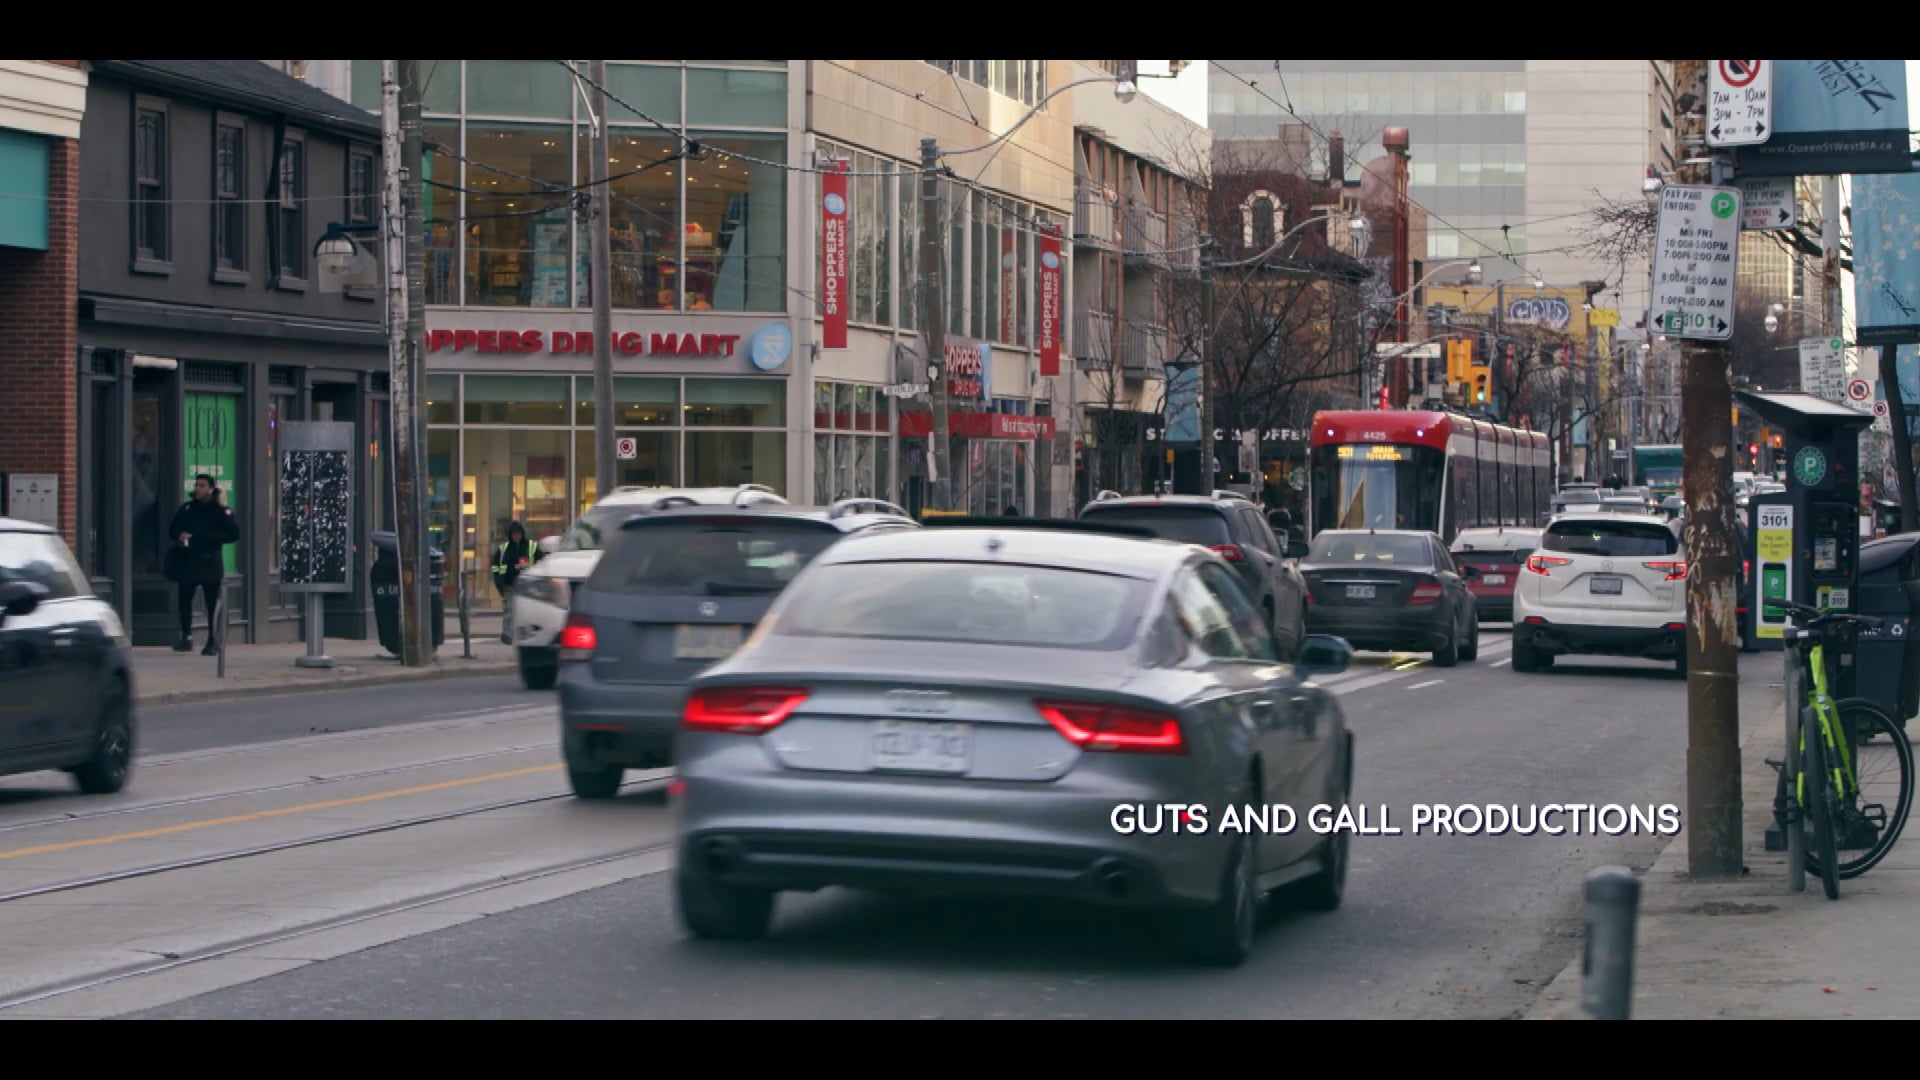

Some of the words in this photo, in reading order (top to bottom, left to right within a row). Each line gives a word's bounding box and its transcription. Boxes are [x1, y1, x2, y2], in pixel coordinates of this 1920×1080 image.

[1713, 92, 1730, 105] 7AM
[1745, 88, 1766, 102] 10AM
[1713, 108, 1731, 121] 3PM
[1747, 106, 1765, 119] 7PM
[1760, 141, 1892, 153] www.QueenStWestBIA.ca
[1665, 189, 1681, 199] PAY
[827, 219, 837, 315] SHOPPERS
[1043, 272, 1052, 350] SHOPPERS
[425, 329, 543, 352] PPERS
[650, 333, 740, 356] MART
[188, 406, 227, 450] LCBO
[1762, 516, 1788, 526] 3101
